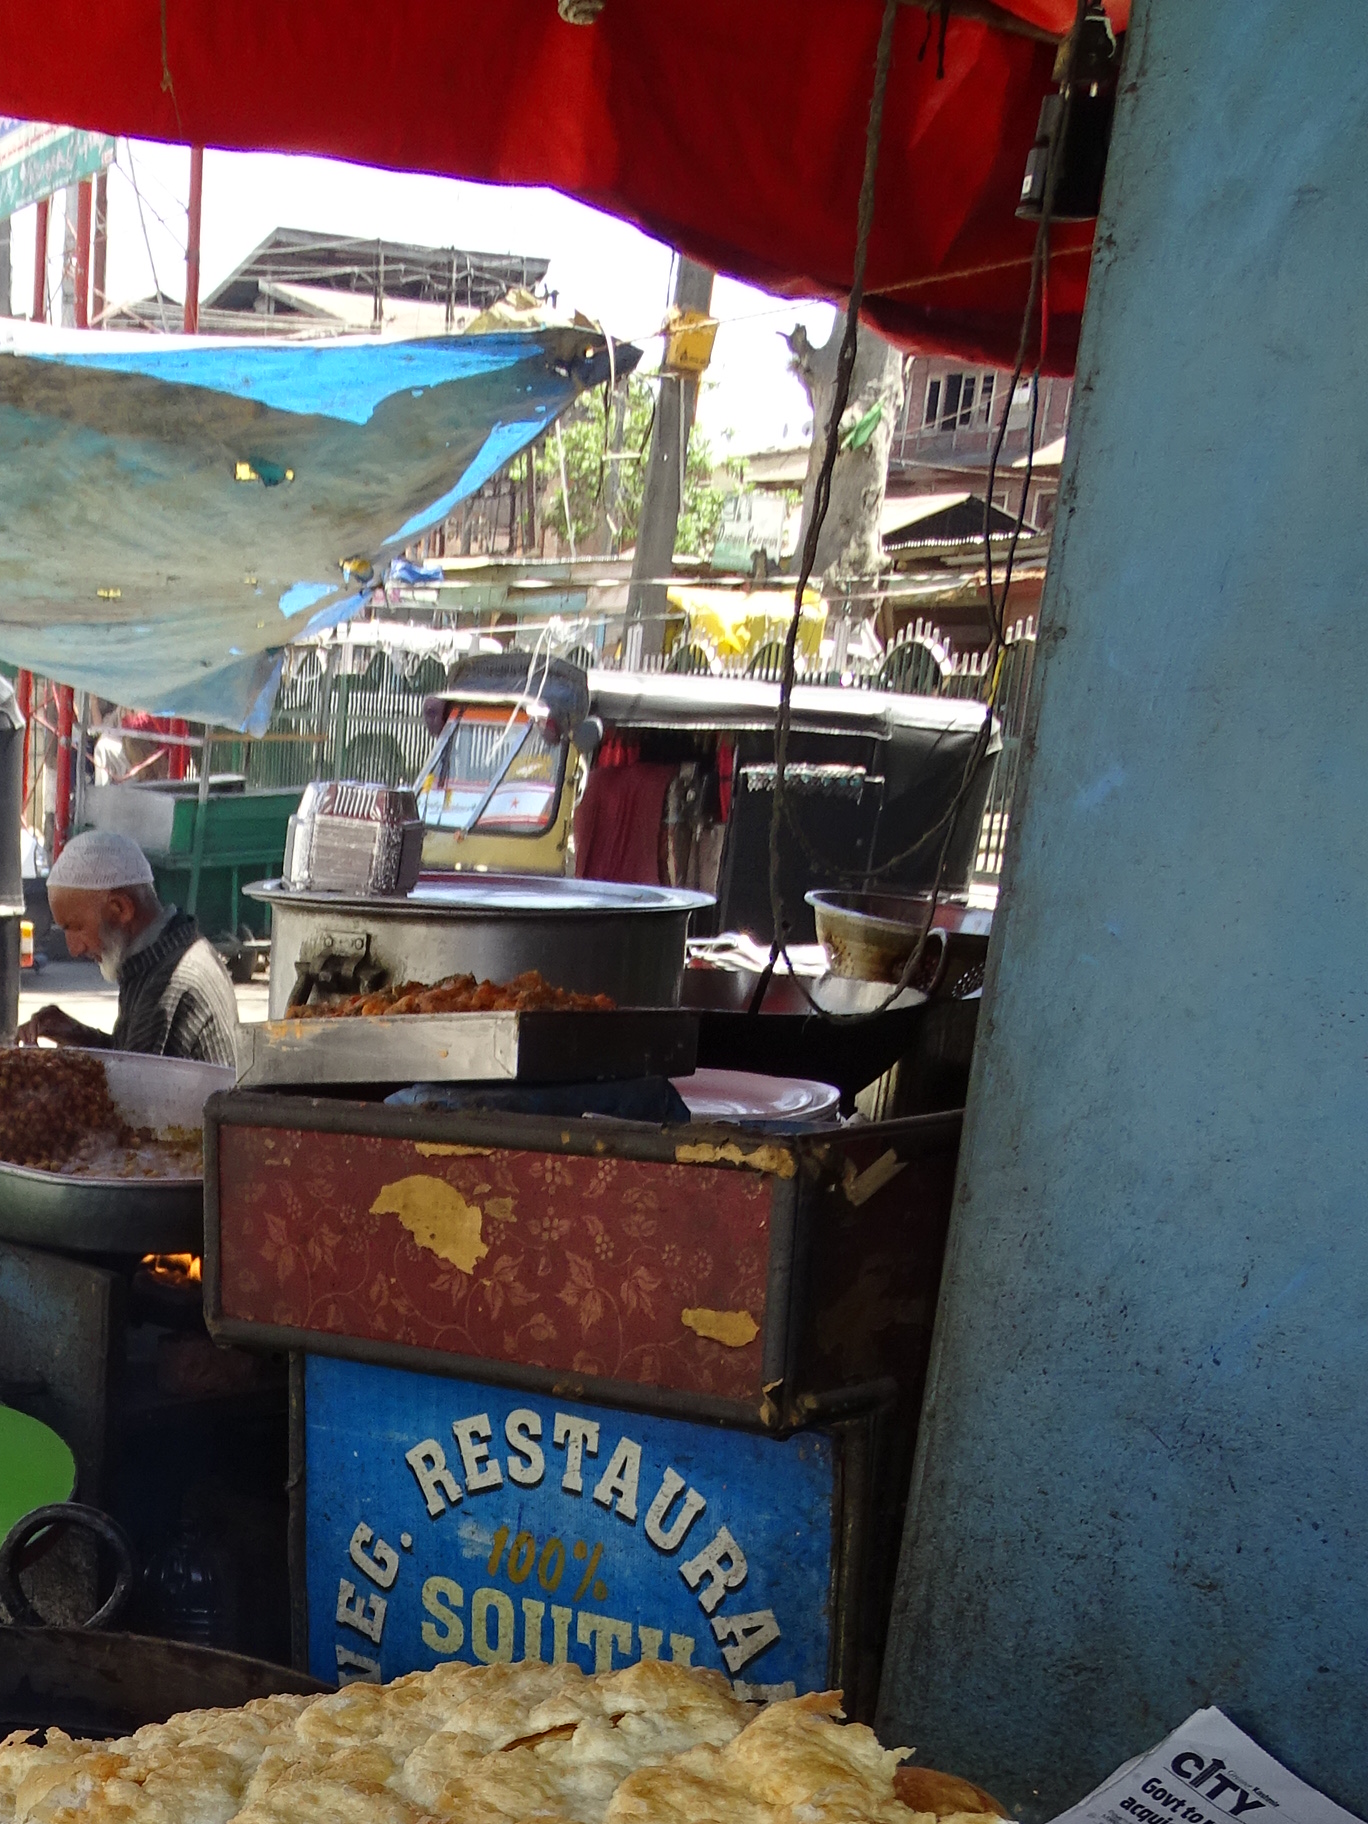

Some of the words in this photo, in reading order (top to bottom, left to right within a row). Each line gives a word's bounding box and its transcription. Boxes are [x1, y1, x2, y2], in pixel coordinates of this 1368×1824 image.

[335, 1522, 413, 1686] VEG.
[404, 1408, 796, 1701] RESTAURA
[486, 1525, 608, 1602] 100%
[1141, 1777, 1185, 1813] Govt
[1181, 1804, 1204, 1824] to
[1170, 1751, 1266, 1817] CITY
